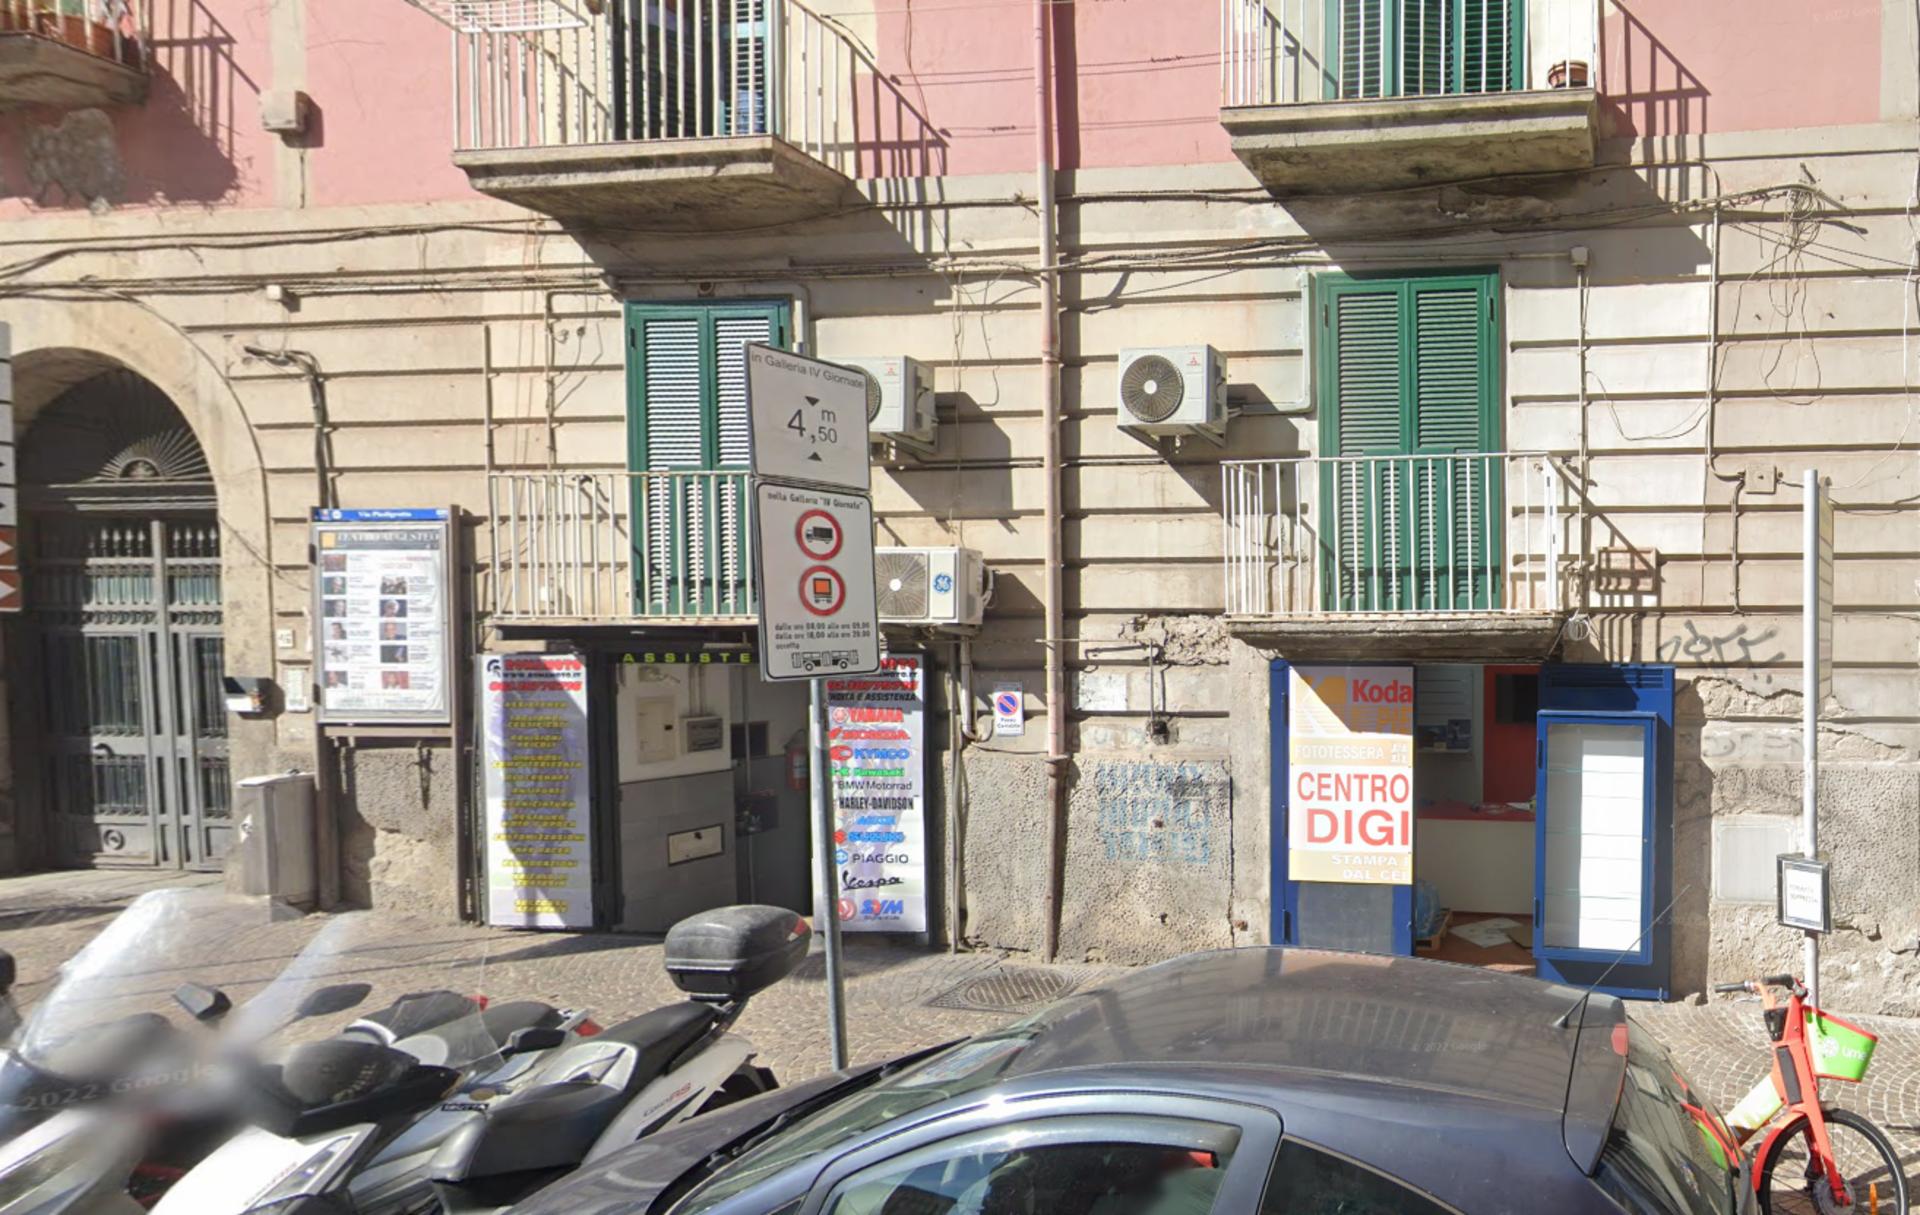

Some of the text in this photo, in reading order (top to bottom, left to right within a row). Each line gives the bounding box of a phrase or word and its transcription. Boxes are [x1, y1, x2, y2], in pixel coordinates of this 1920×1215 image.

[752, 353, 761, 362] in
[765, 355, 806, 376] Galleria
[809, 367, 820, 378] IV
[821, 409, 836, 423] m
[623, 653, 752, 663] ASSISTE
[865, 692, 916, 702] ASSISTENZA
[1352, 679, 1412, 704] Koda
[854, 748, 910, 760] KYMCO
[1295, 745, 1385, 760] FOTOTESSERA
[838, 780, 912, 791] BMW Motorrad
[1297, 771, 1410, 804] CENTRO
[838, 797, 914, 810] HARLEY-DAVIDSON
[1306, 808, 1410, 846] DIGI
[852, 853, 909, 864] PIAGGIO
[1331, 856, 1398, 867] STAMPA
[842, 870, 904, 891] Vespa
[1344, 869, 1374, 880] DAL
